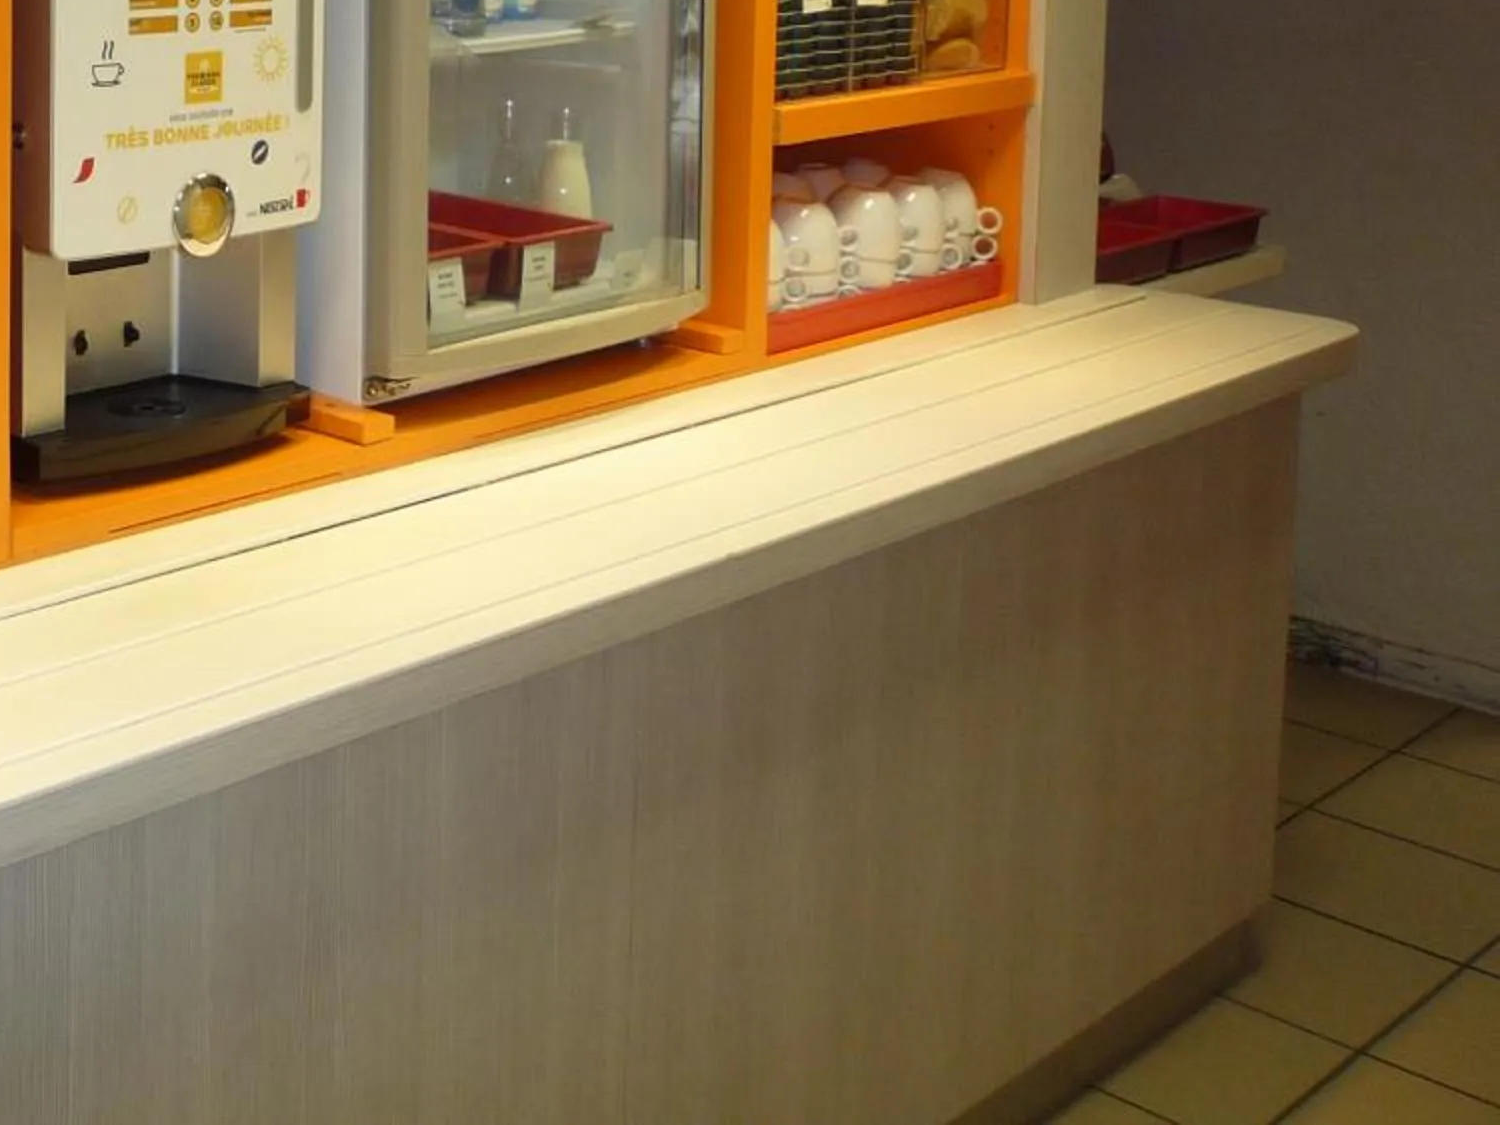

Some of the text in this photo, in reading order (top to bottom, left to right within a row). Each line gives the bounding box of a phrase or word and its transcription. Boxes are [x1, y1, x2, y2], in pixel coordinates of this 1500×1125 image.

[105, 125, 149, 150] TRÈS
[153, 124, 210, 146] BONNE
[212, 111, 283, 139] JOURNÉE
